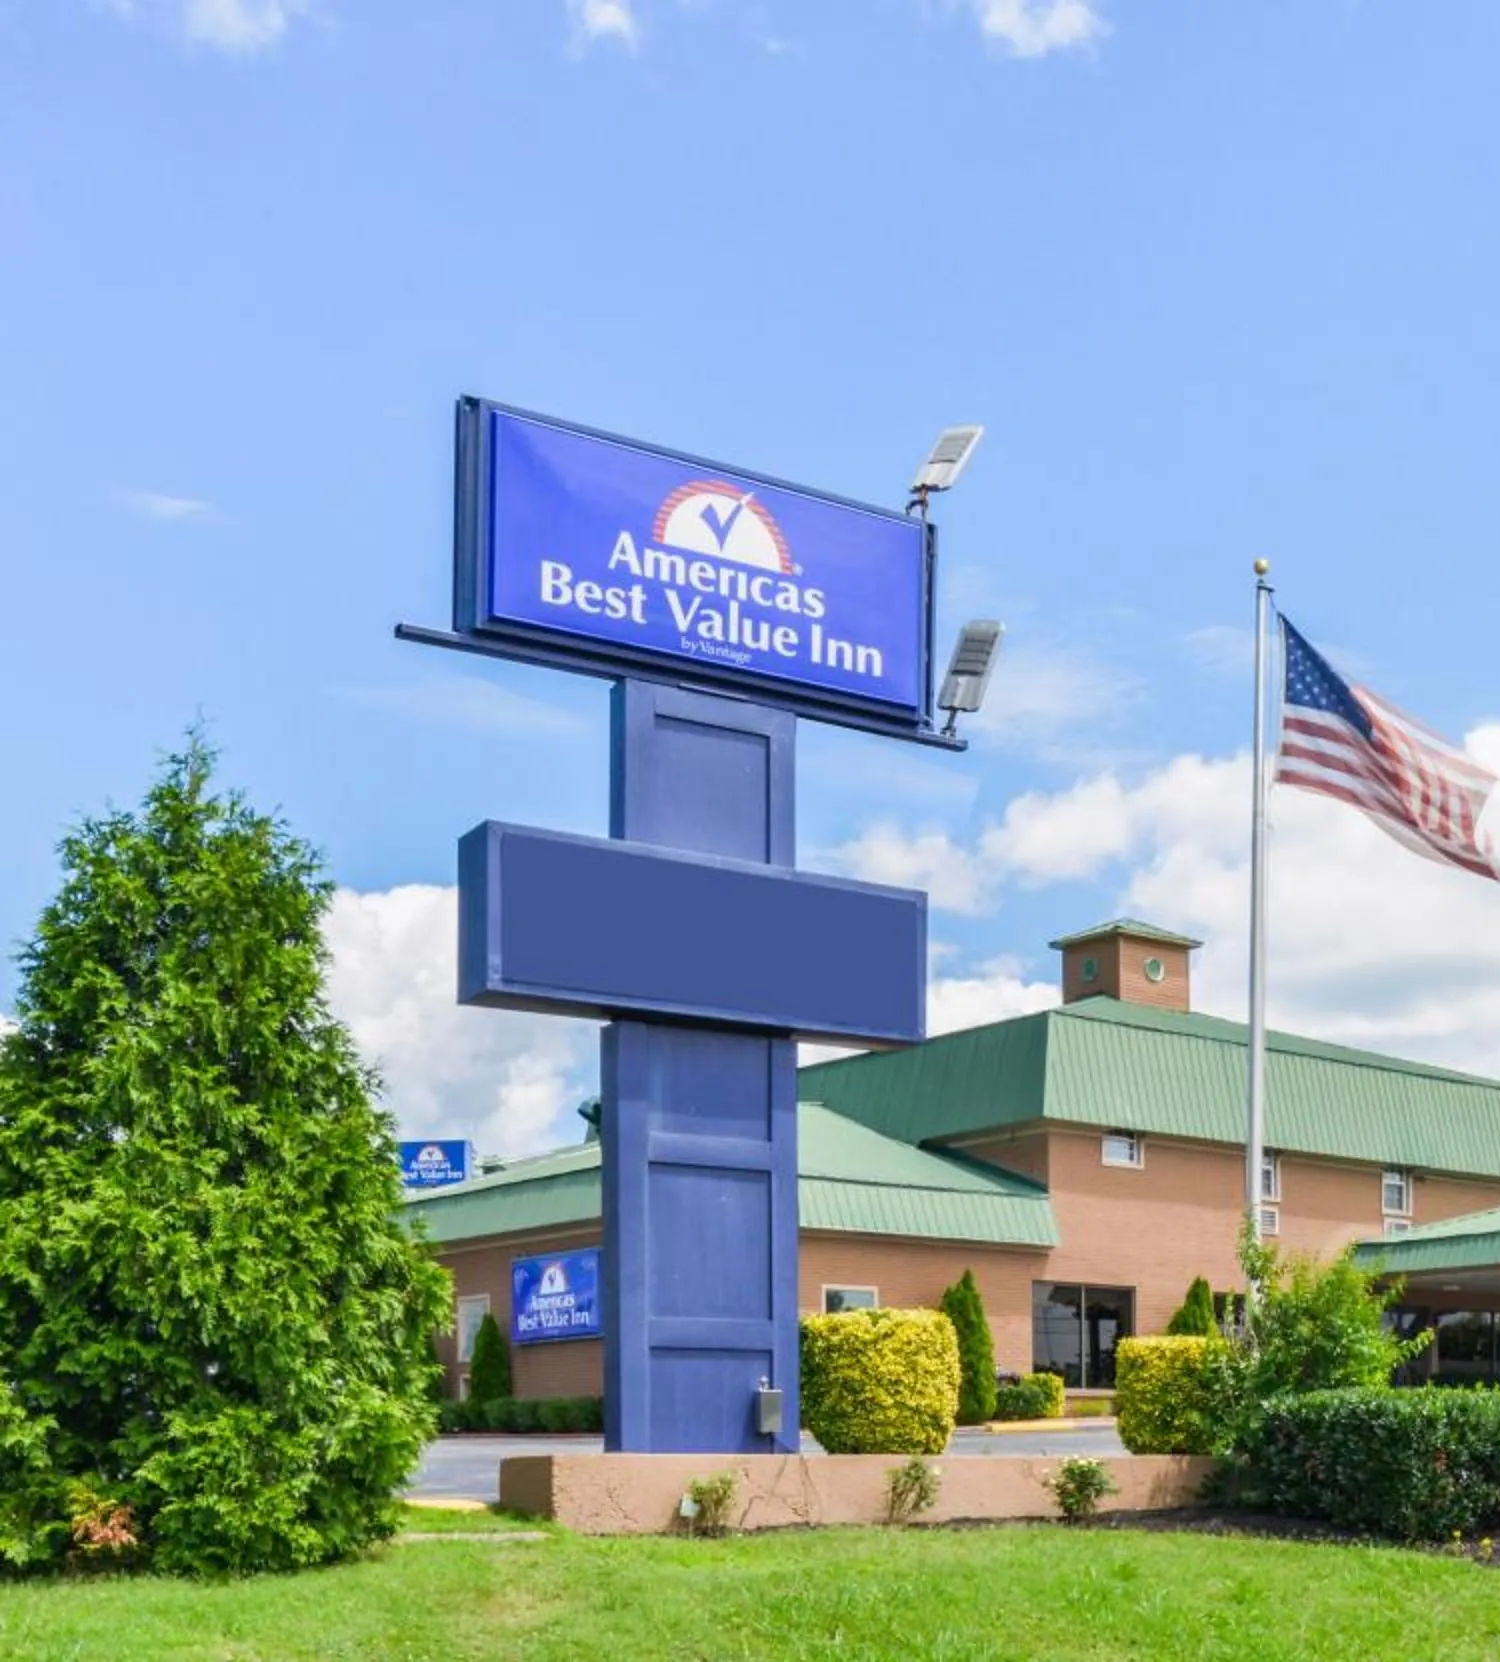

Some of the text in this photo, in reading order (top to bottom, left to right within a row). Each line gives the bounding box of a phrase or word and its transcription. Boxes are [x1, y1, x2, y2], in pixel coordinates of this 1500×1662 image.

[540, 560, 883, 677] Best Value Inn
[608, 530, 826, 618] Americas
